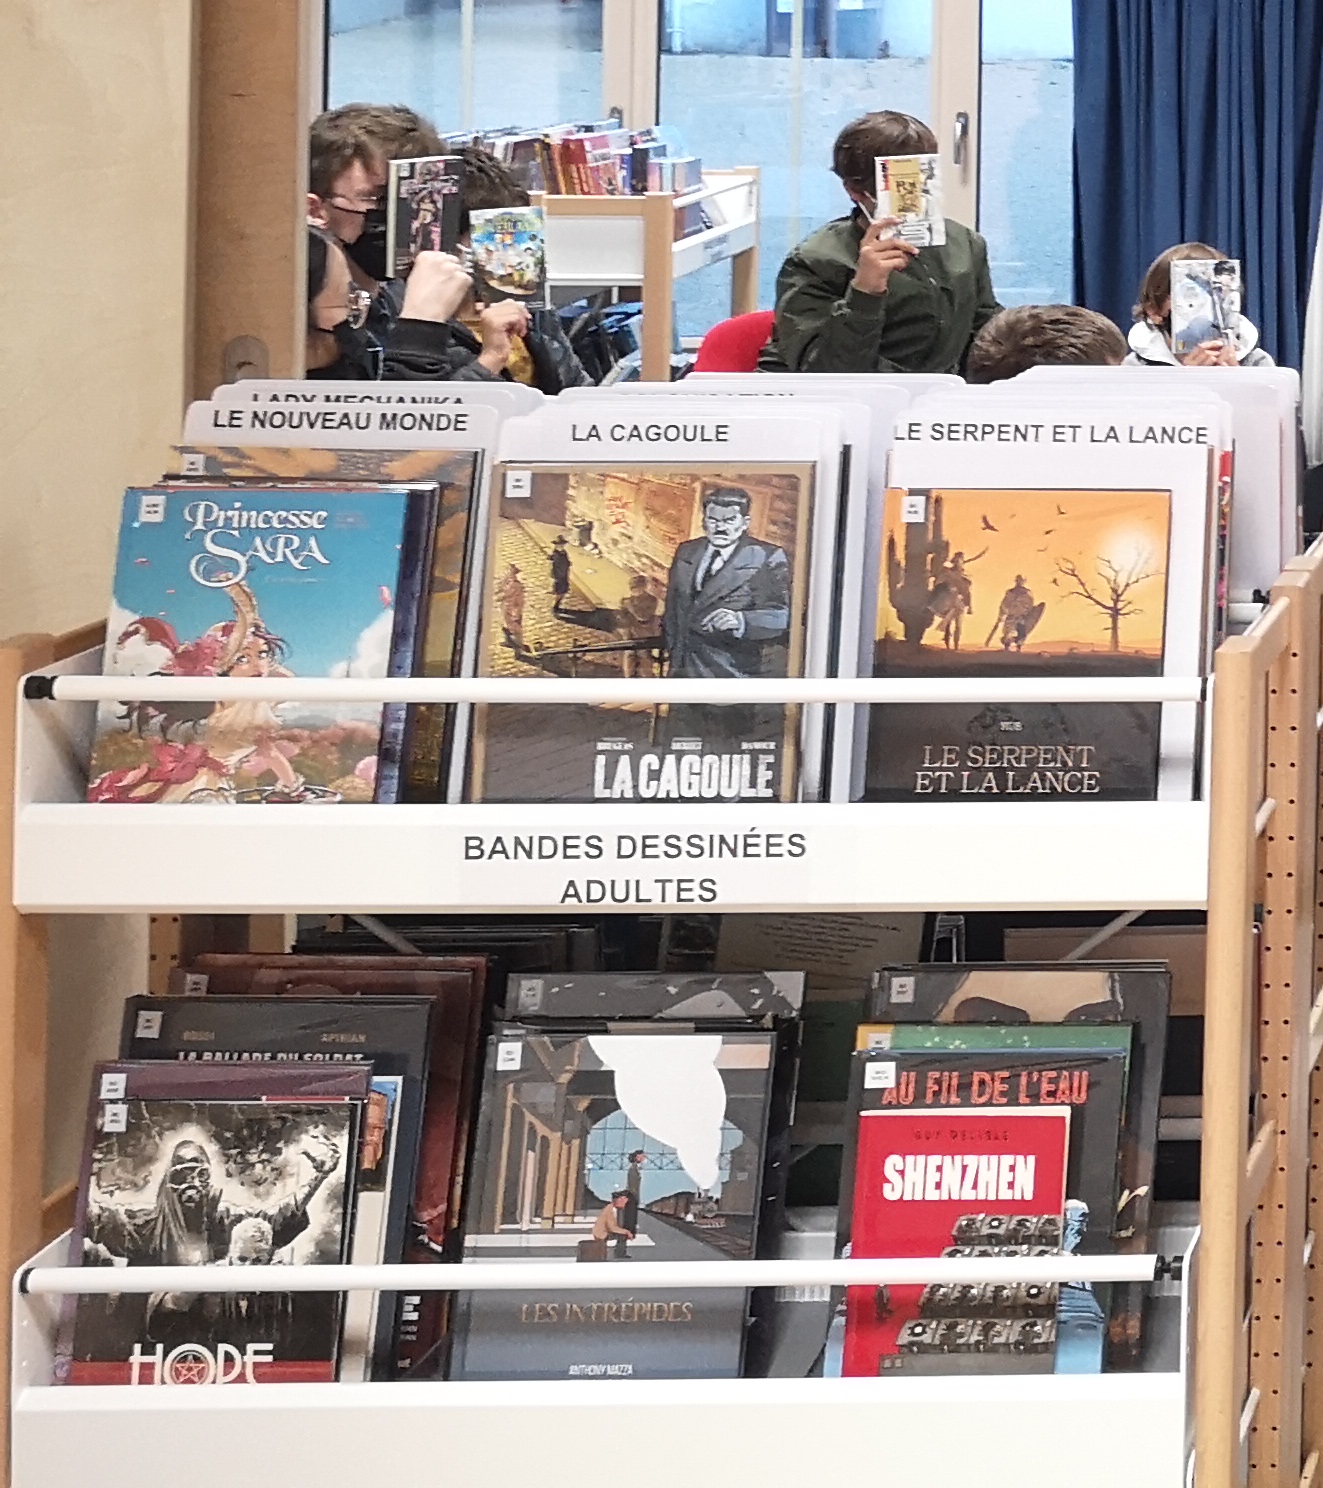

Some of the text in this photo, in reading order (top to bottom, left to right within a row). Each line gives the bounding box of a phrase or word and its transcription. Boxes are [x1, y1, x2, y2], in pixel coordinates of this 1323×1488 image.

[213, 410, 468, 431] LE NOUVEAU MONDE
[572, 424, 730, 442] LA CAGOULE
[895, 423, 1208, 445] LE SERPENT ET LA LANCE
[184, 502, 329, 539] Princesse
[190, 529, 331, 588] SARA
[922, 745, 1096, 768] LE SERPENT
[594, 753, 775, 799] LA CAGOULE
[915, 771, 1100, 793] ET LA LANCE
[464, 826, 807, 860] BANDES DESSINÉES
[560, 878, 718, 904] ADULTES
[925, 1071, 962, 1104] FIL
[970, 1071, 1010, 1104] DE
[1018, 1071, 1089, 1104] L'EAU
[882, 1154, 1036, 1201] SHENZHEN
[521, 1297, 694, 1323] LES INTRÉPIDES
